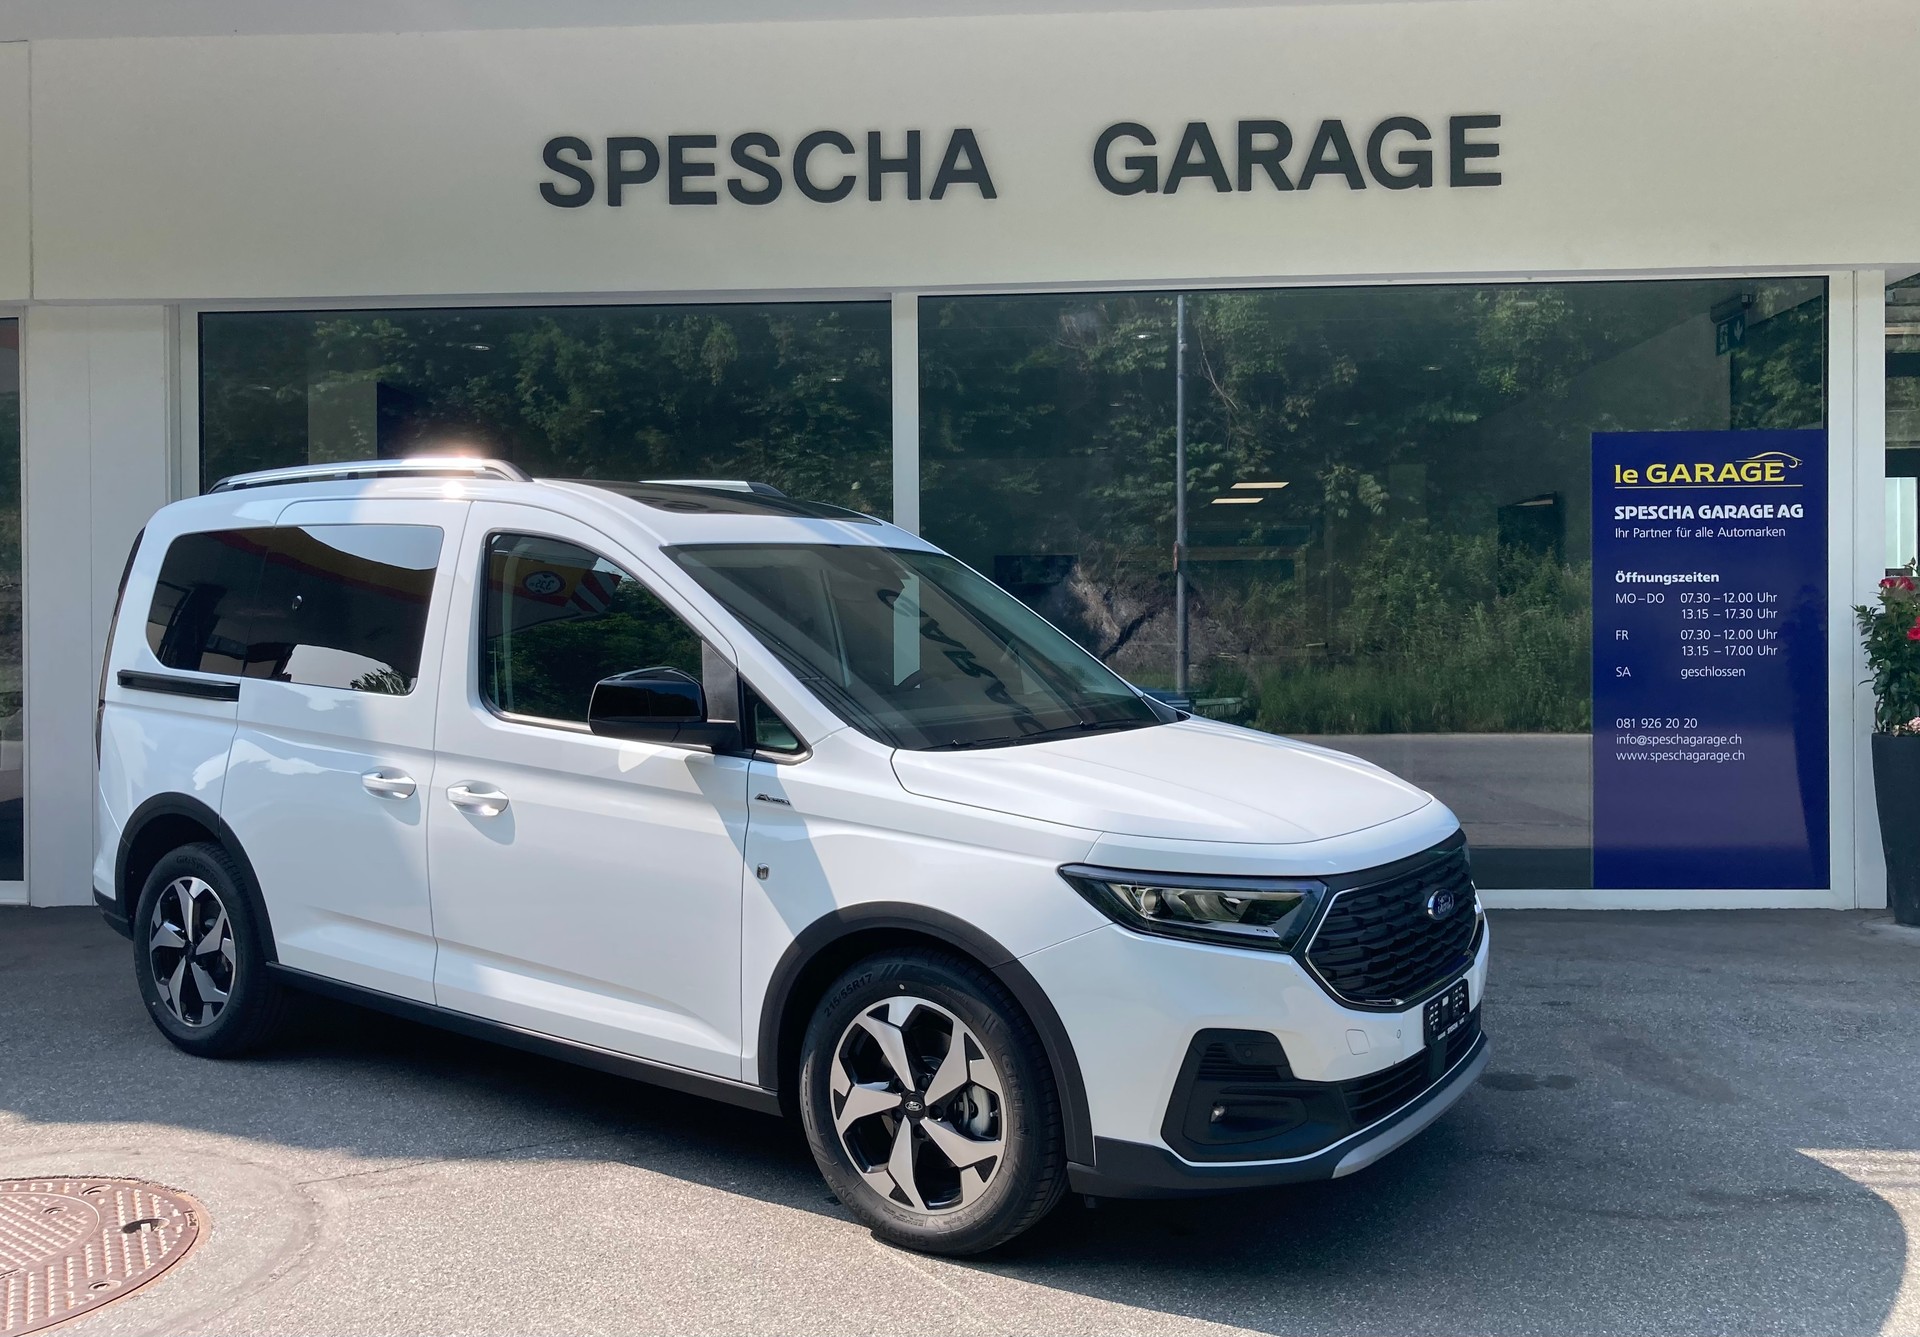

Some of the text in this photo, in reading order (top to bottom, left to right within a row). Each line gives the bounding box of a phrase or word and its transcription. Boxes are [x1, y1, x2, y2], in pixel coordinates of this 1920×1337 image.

[540, 114, 1502, 209] SPESCHA GARAGE
[1614, 463, 1786, 484] le GARAGE
[1614, 503, 1804, 520] SPESCHA GARAGE AG
[1615, 526, 1786, 539] Ihr Partner für alle Automarken
[1615, 570, 1720, 586] Öffnungszeiten
[1680, 592, 1711, 604] 07.30
[1723, 592, 1754, 604] 12.00
[1757, 592, 1778, 603] Uhr
[1681, 608, 1709, 620] 13.15
[1725, 608, 1754, 620] 17.30
[1757, 608, 1778, 620] Uhr
[1615, 629, 1629, 641] FR
[1680, 629, 1711, 641] 07.30
[1723, 629, 1754, 640] 12.00
[1757, 629, 1778, 640] Uhr
[1681, 645, 1709, 657] 13.15
[1725, 645, 1754, 656] 17.00
[1757, 645, 1778, 656] Uhr
[1615, 665, 1746, 680] SA geschlossen
[1615, 717, 1698, 729] 081 926 20 20
[1616, 733, 1742, 748] info@speschagarage.ch
[1615, 749, 1746, 764] www.speschagarage.ch
